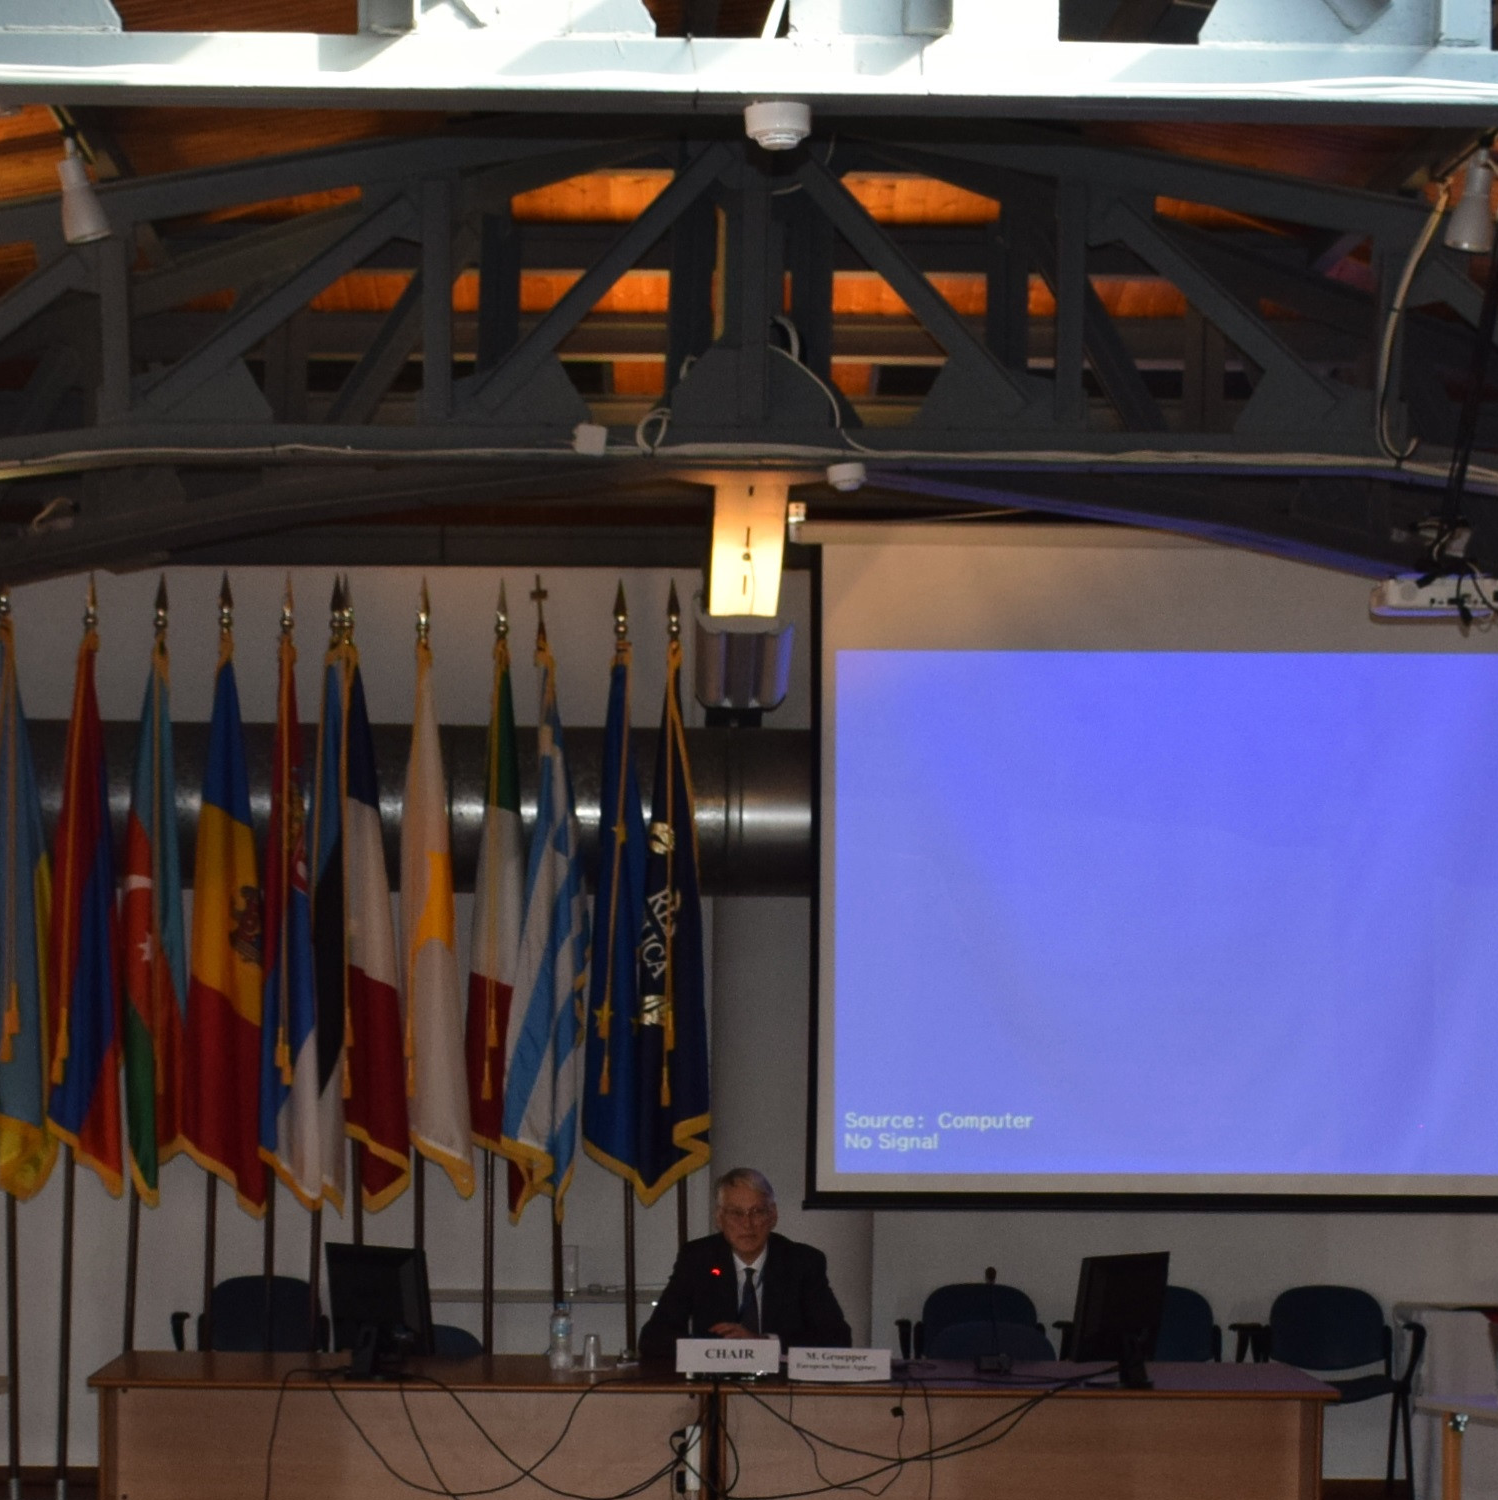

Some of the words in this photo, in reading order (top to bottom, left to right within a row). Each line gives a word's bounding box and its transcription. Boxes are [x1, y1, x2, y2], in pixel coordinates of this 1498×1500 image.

[844, 1111, 924, 1129] Source:
[937, 1112, 1033, 1131] Computer
[844, 1133, 872, 1149] No
[878, 1132, 939, 1152] Signal
[704, 1348, 755, 1360] CHAIR
